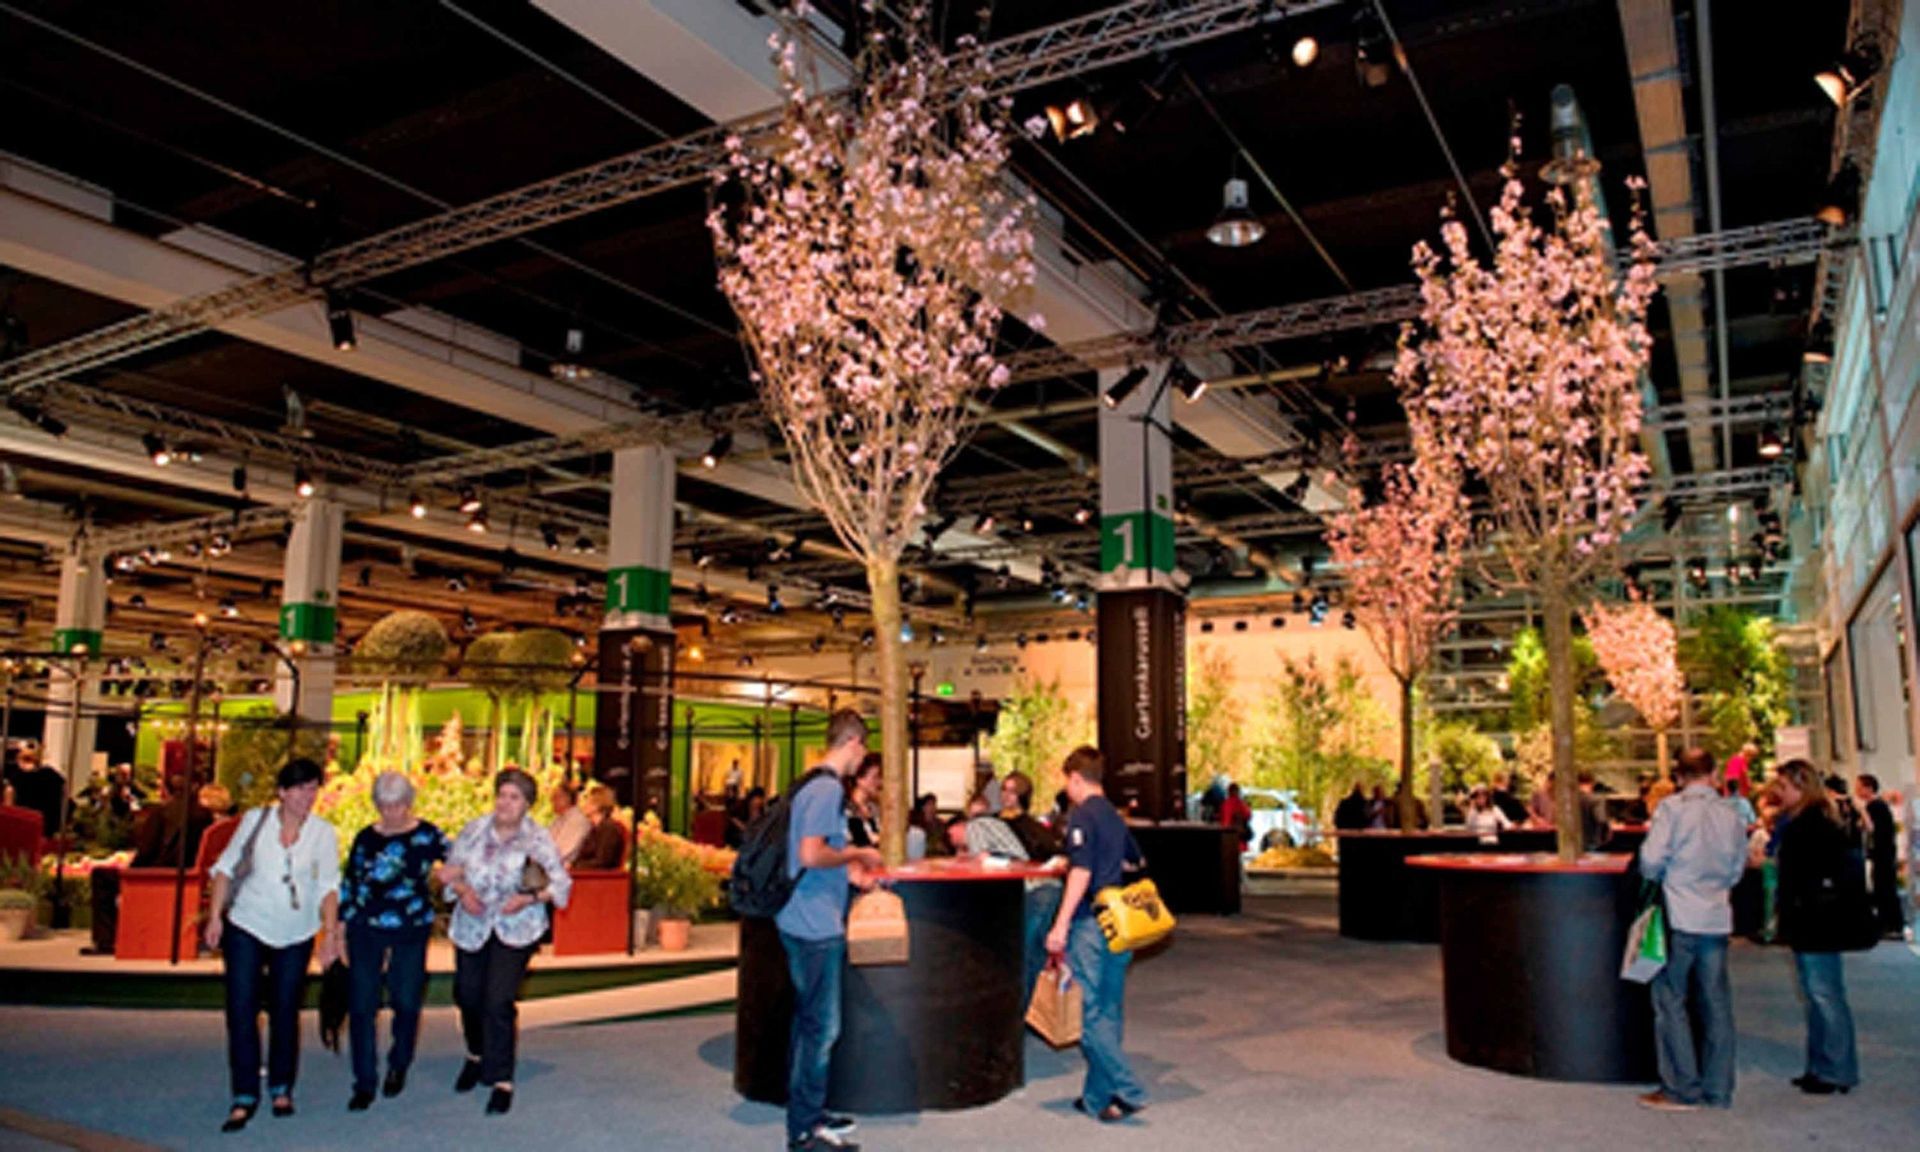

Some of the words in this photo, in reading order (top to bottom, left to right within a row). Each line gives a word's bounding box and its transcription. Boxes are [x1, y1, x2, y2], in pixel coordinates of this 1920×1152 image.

[1114, 520, 1133, 563] 1
[614, 573, 628, 607] 1
[285, 607, 297, 636] 1
